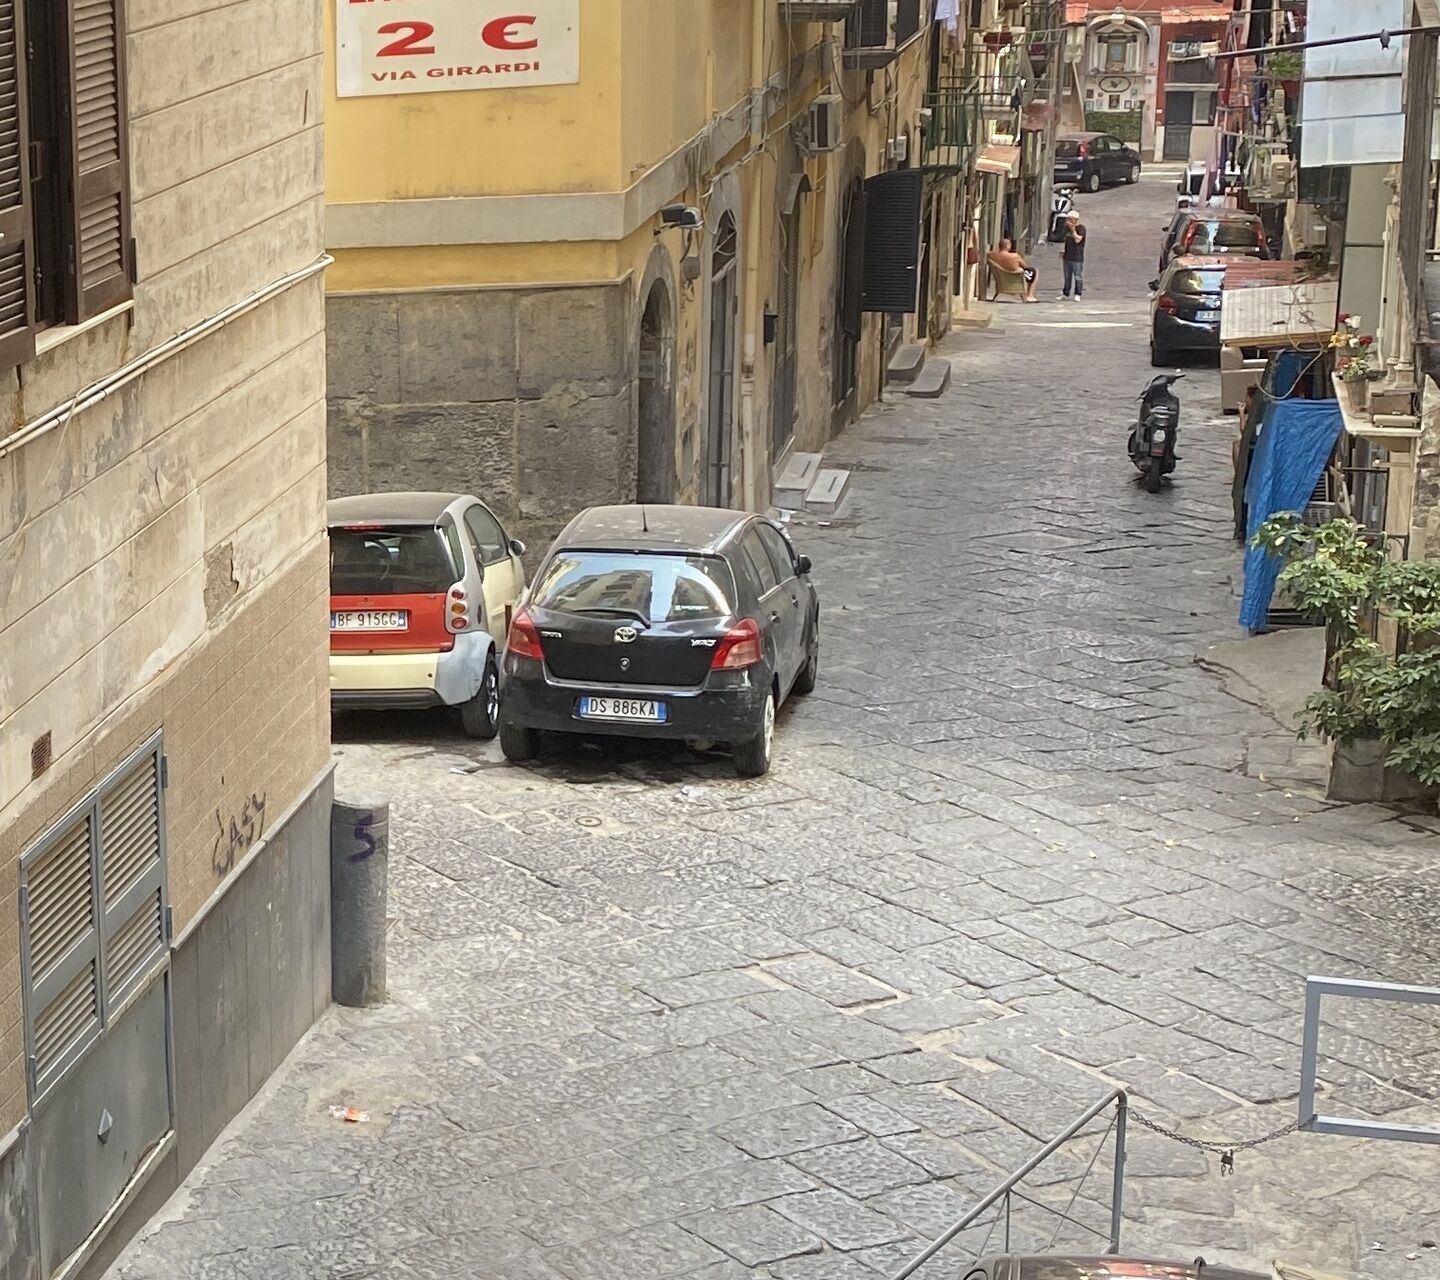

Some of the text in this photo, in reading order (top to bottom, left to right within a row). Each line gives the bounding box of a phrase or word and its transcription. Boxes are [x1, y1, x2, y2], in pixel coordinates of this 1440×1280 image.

[376, 15, 538, 57] 2 €
[371, 61, 540, 82] VIA GIRARDI
[337, 613, 353, 627] BF
[590, 698, 656, 717] DS 886KA
